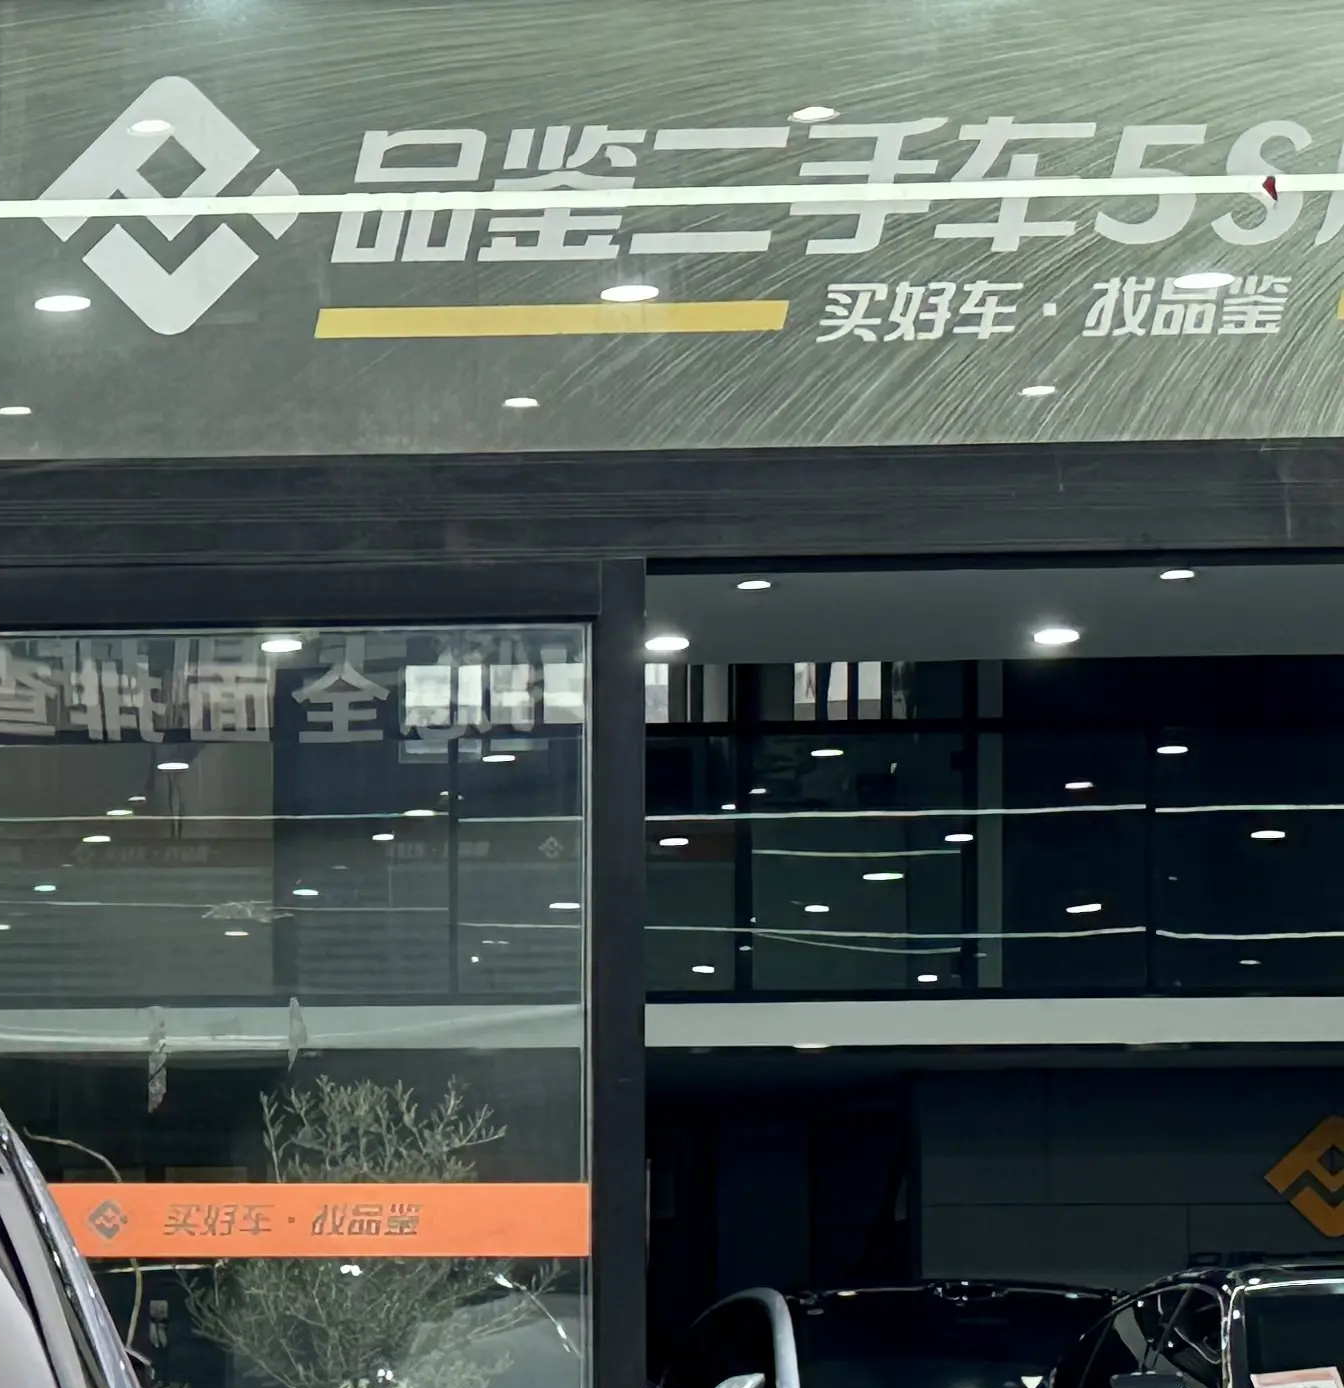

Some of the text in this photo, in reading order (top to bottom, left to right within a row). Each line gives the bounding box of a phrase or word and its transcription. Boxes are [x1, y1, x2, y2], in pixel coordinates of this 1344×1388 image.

[330, 116, 1344, 263] 品鉴二手车5S
